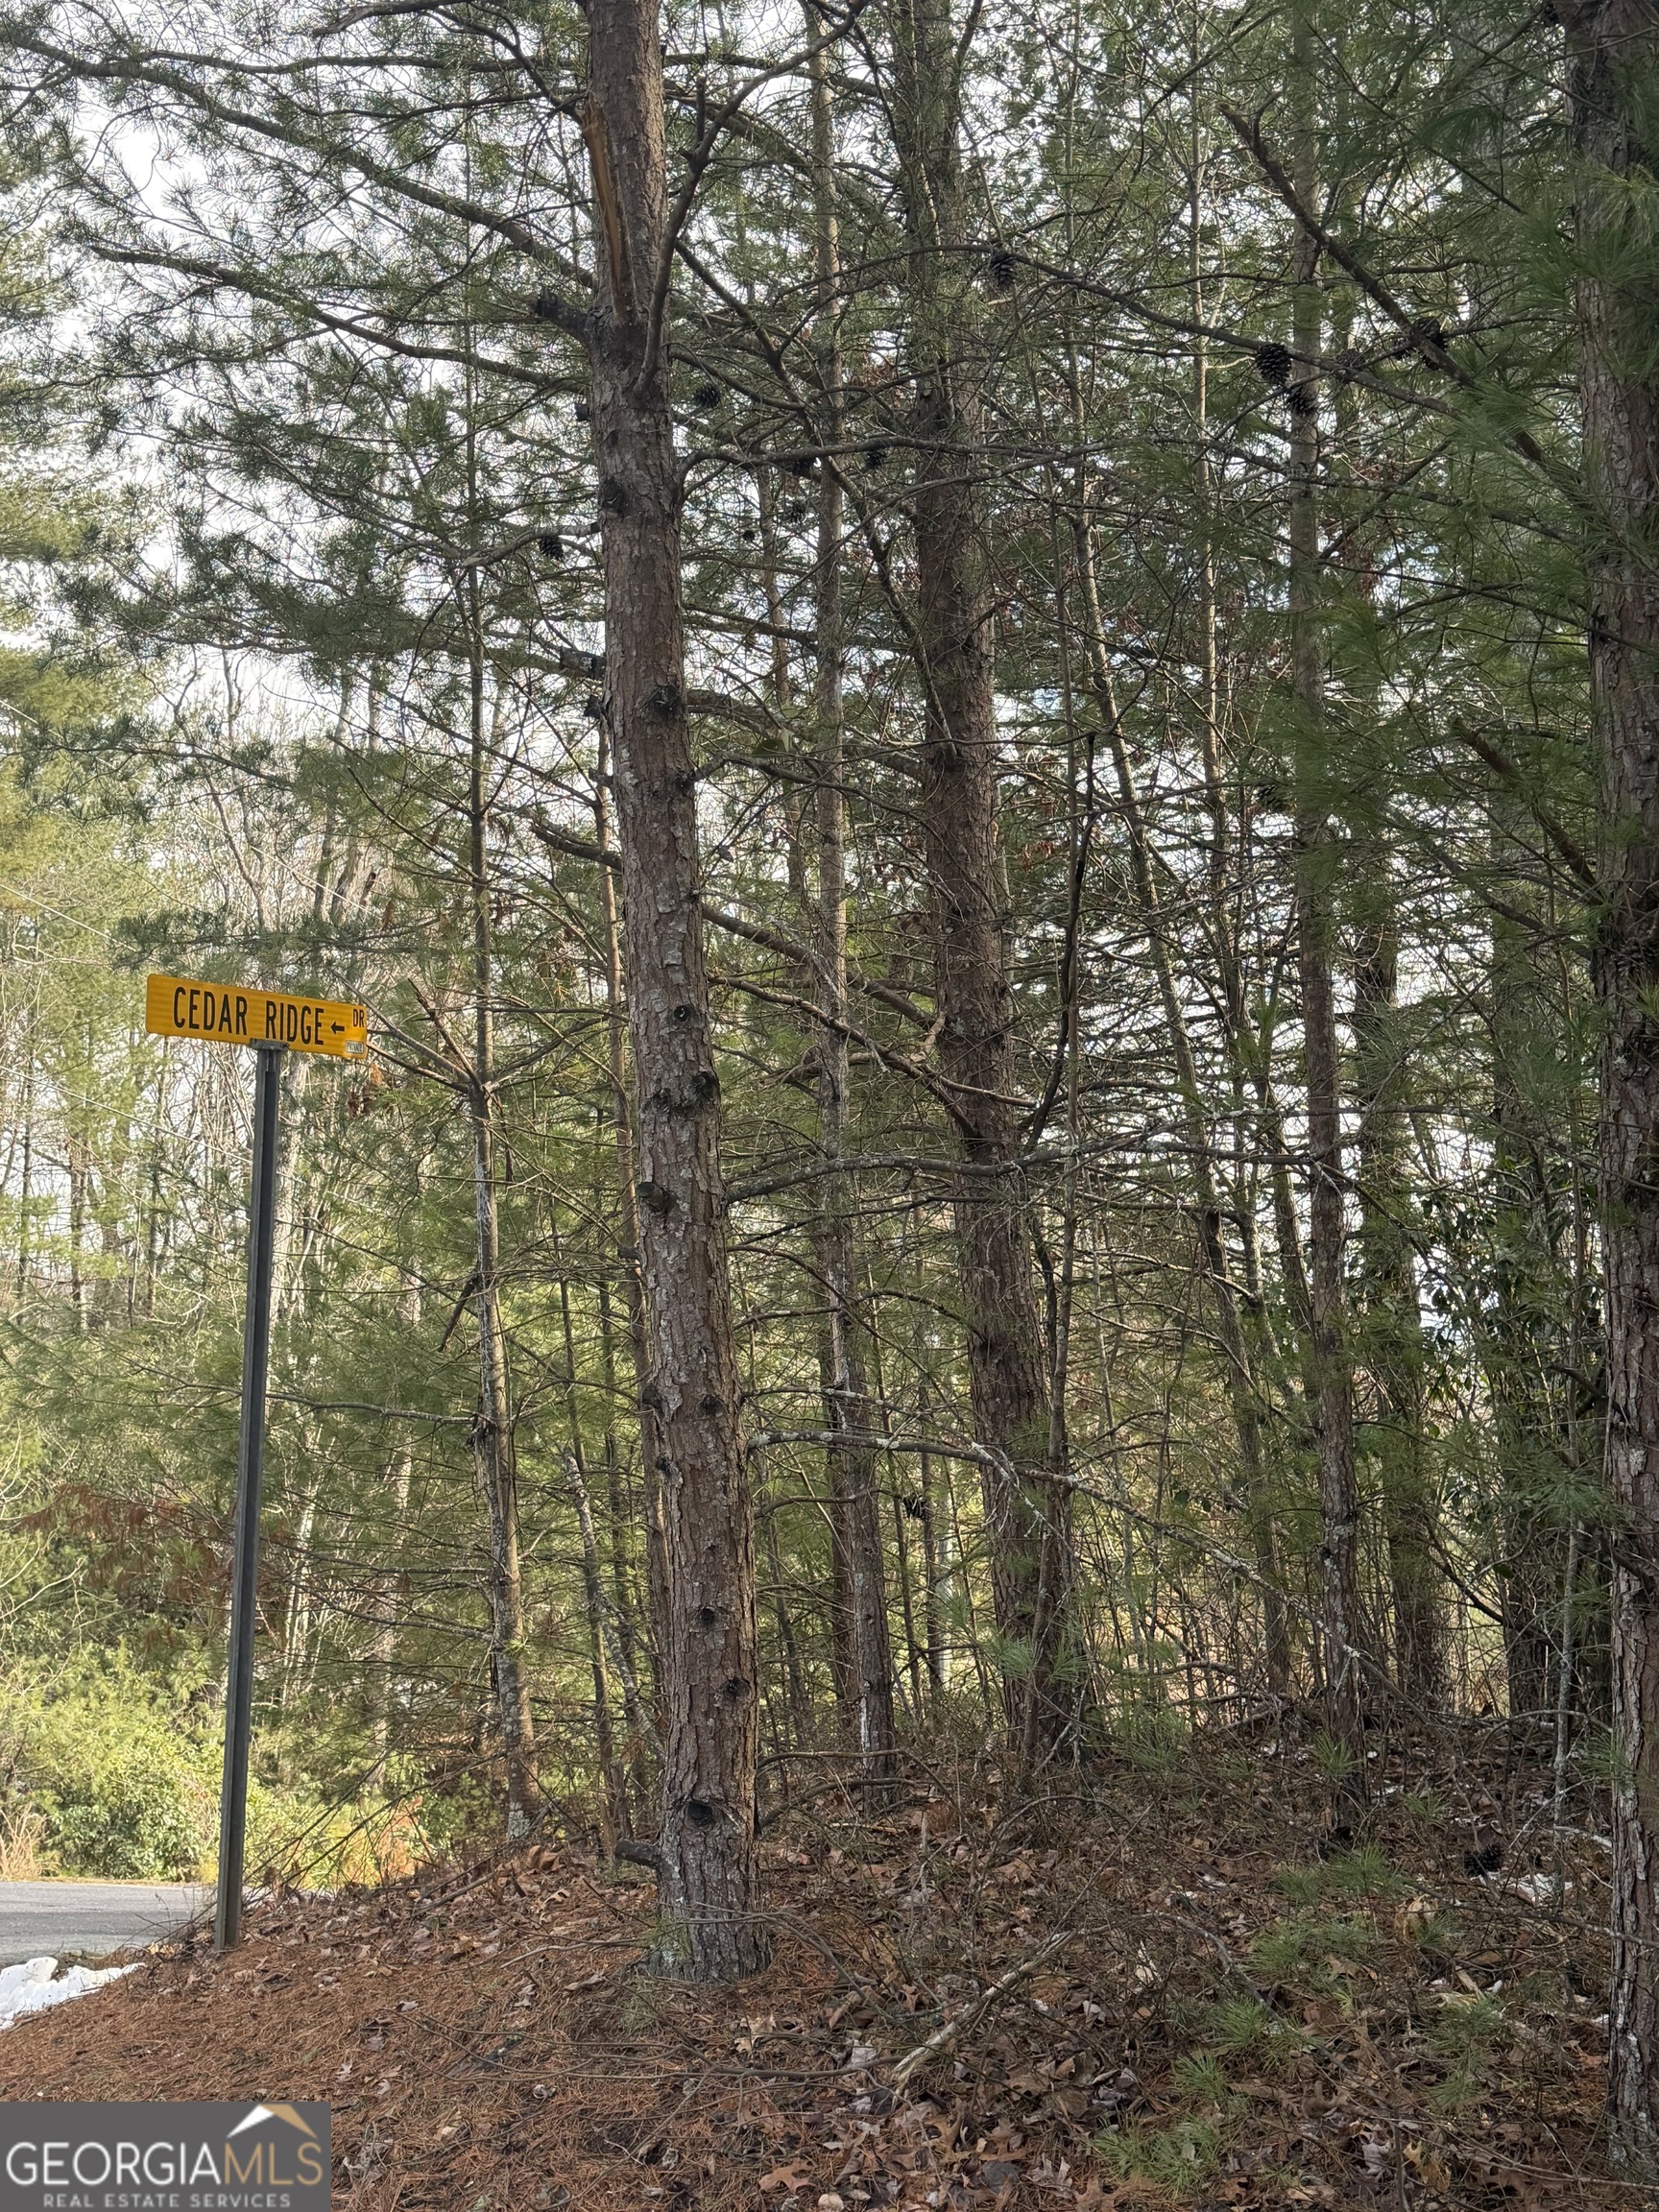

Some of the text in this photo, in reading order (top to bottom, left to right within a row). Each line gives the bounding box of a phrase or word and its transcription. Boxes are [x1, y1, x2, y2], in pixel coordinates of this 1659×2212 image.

[174, 986, 365, 1046] CEDAR RIDGE DR
